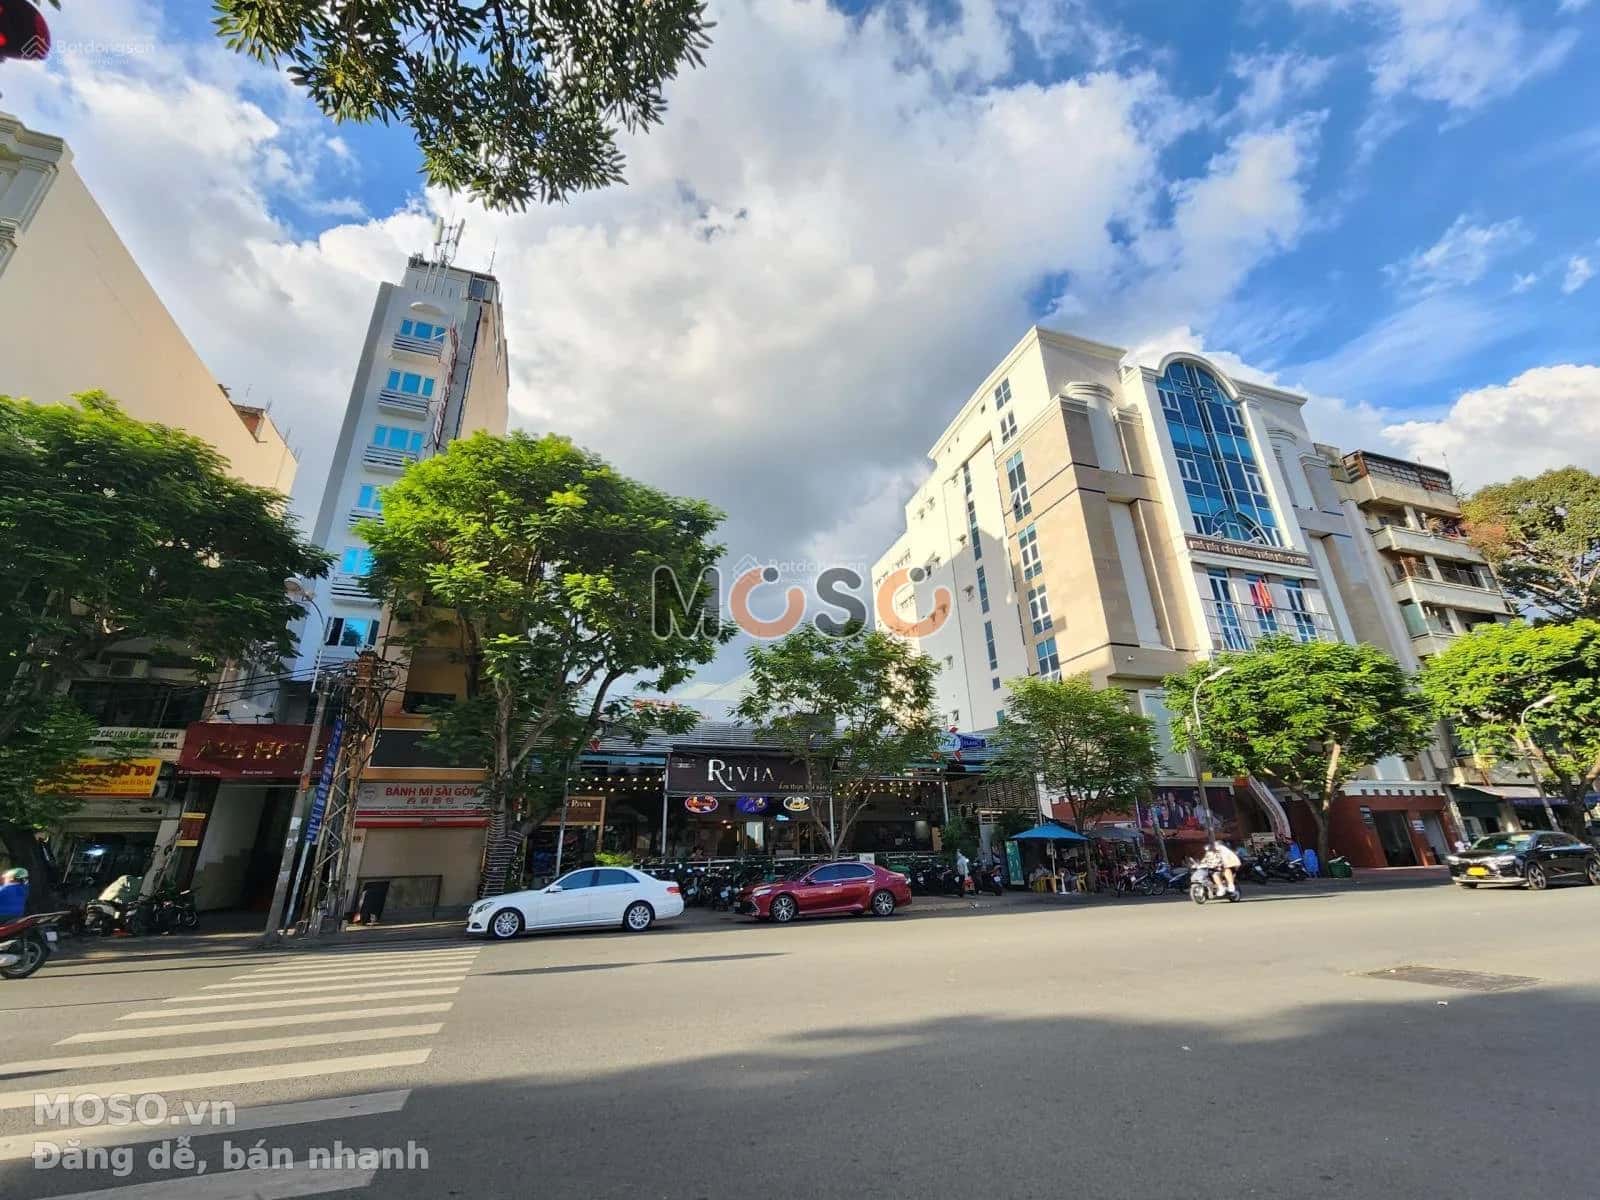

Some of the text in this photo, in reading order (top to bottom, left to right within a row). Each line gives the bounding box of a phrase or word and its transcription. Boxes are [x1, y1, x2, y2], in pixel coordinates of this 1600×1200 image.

[707, 758, 775, 791] RIVIA
[385, 784, 417, 796] BÁNH
[419, 784, 433, 796] MÌ
[435, 784, 452, 796] SÀI
